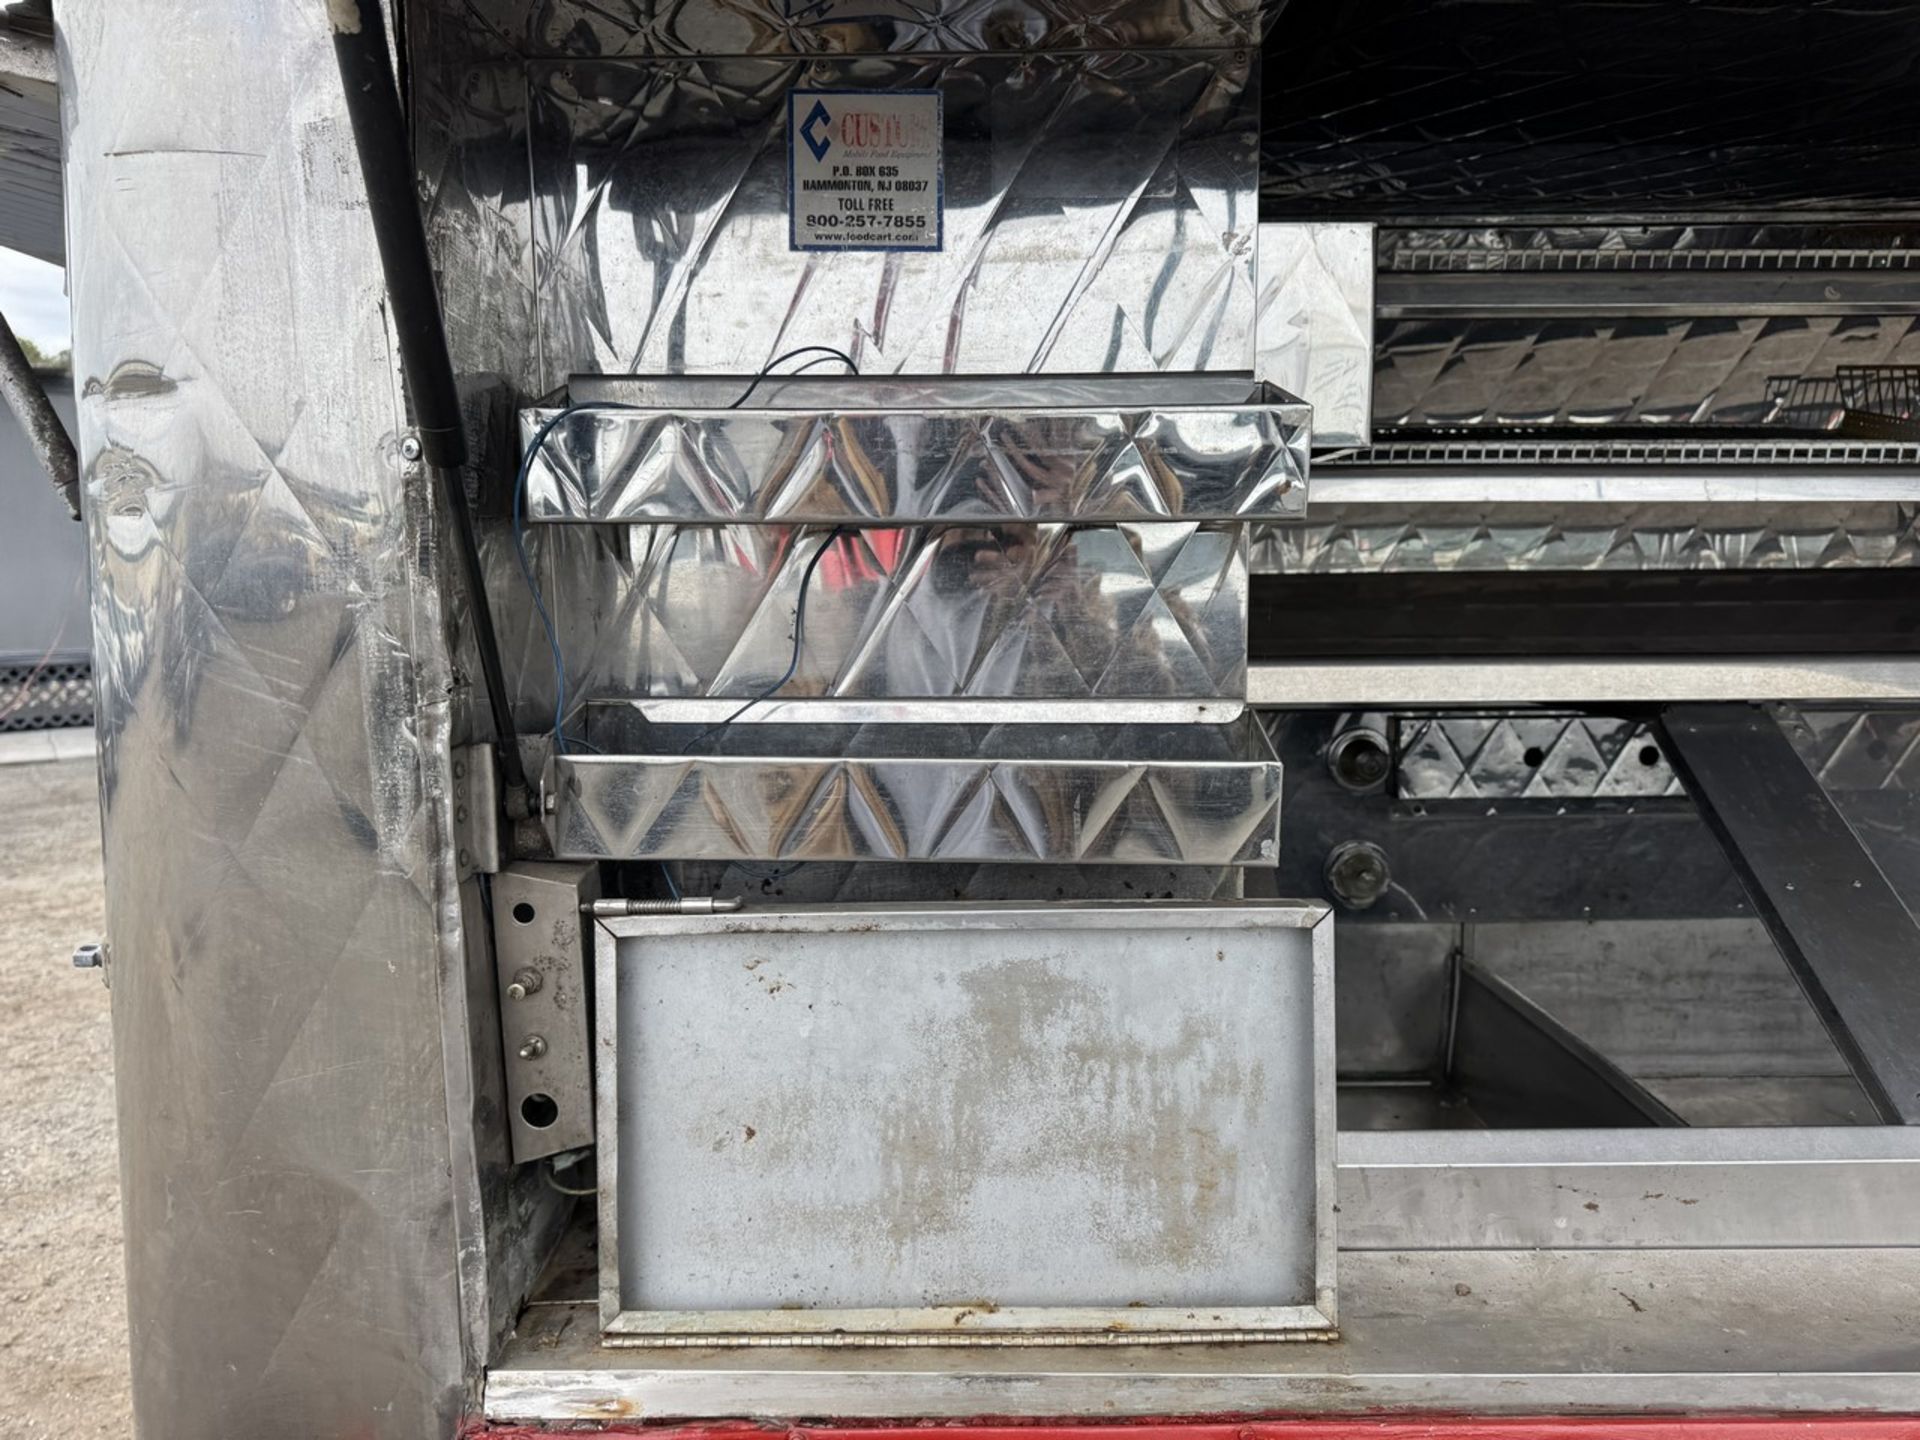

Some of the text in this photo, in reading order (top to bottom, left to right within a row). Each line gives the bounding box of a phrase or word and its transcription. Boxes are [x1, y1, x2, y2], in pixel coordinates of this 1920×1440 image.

[841, 113, 931, 148] CUSTO
[832, 166, 899, 177] P.O. BOX 635
[803, 180, 929, 192] HAMMONTON, NJ 08037
[838, 198, 894, 211] TOLL FREE
[806, 215, 926, 228] 800-257-7855
